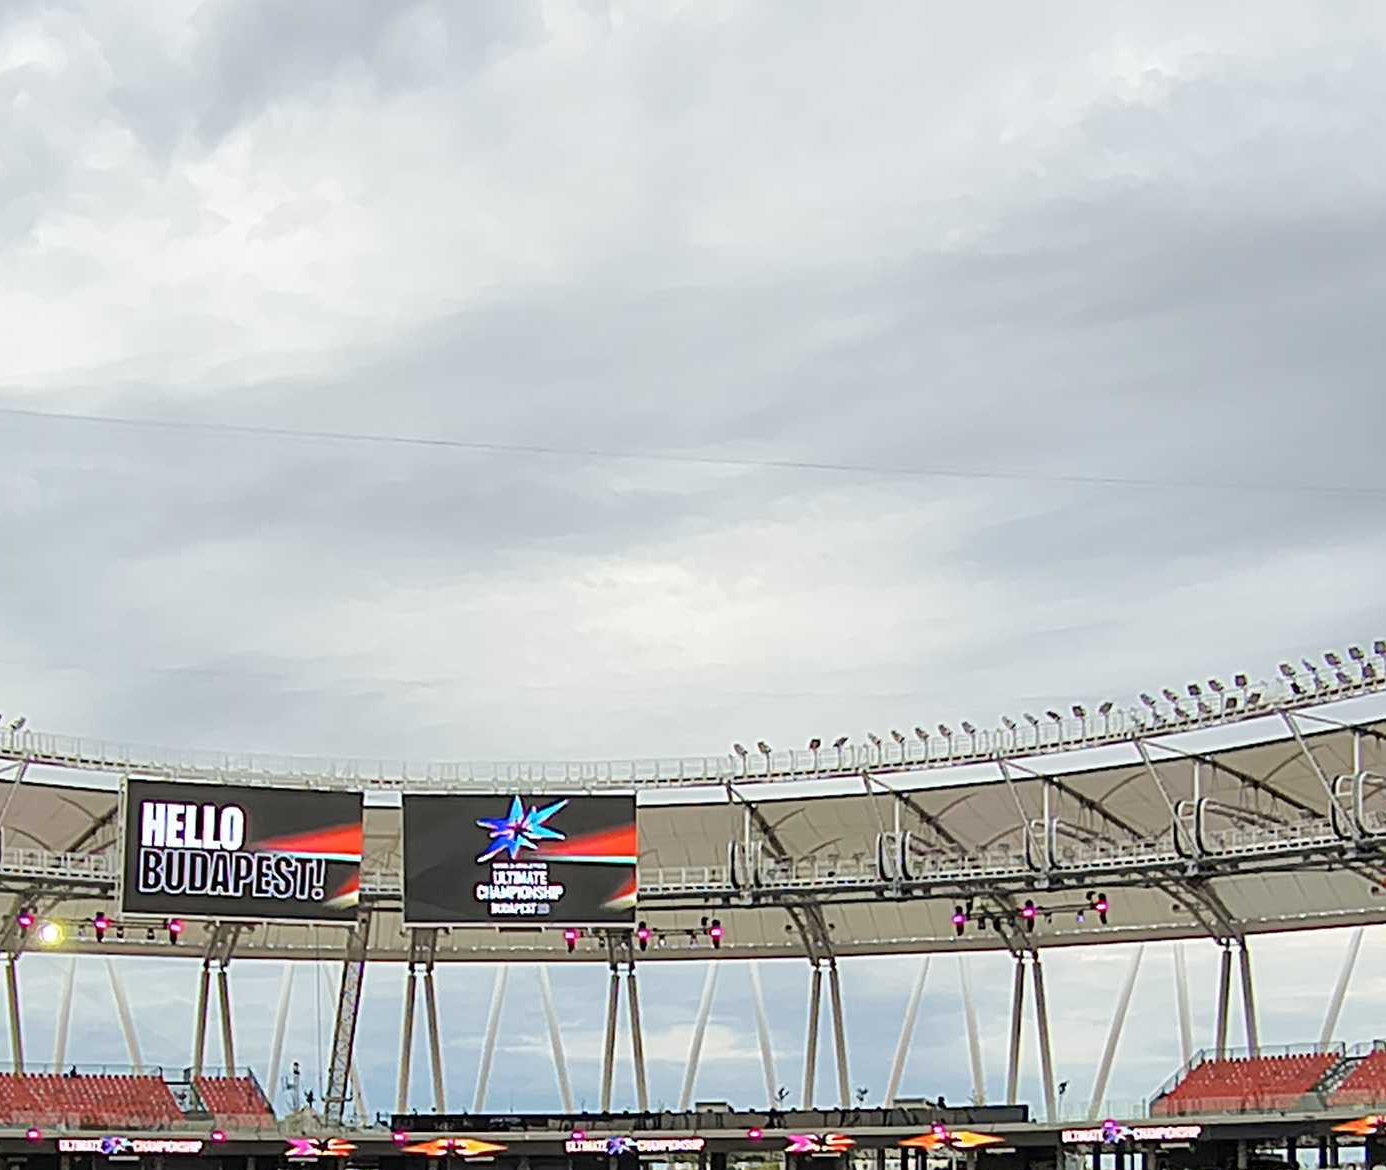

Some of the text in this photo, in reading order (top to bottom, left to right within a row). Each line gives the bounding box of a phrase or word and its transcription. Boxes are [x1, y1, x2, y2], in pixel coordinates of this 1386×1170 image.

[141, 801, 245, 851] HELLO
[139, 848, 326, 900] BUDAPEST!
[492, 870, 548, 885] ULTIMATE
[476, 884, 564, 901] CHAMPIONSHIP
